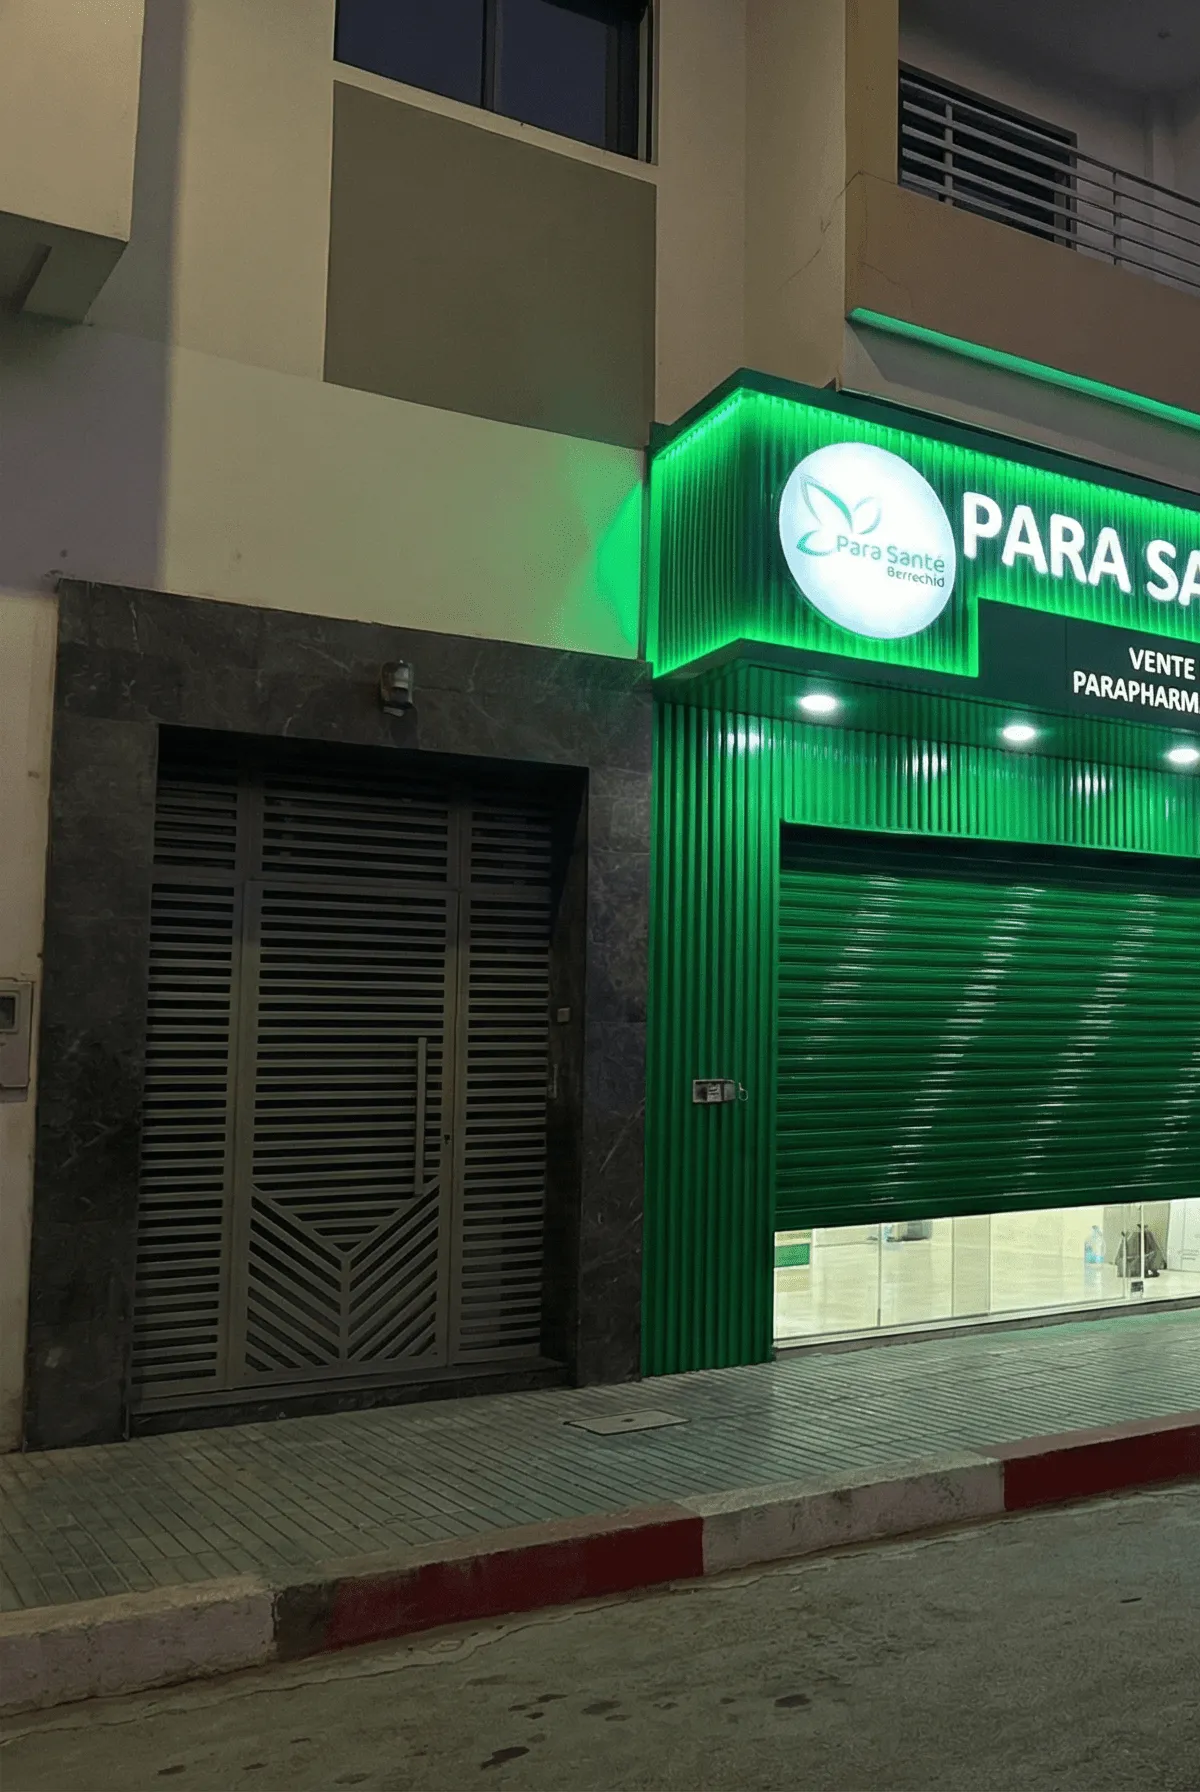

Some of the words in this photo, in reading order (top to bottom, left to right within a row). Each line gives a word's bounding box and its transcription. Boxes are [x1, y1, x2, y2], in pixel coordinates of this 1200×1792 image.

[837, 535, 882, 560] Para
[887, 545, 945, 573] Santé
[963, 491, 1132, 594] PARA
[887, 566, 945, 588] Berrechid
[1129, 647, 1196, 680] VENTE
